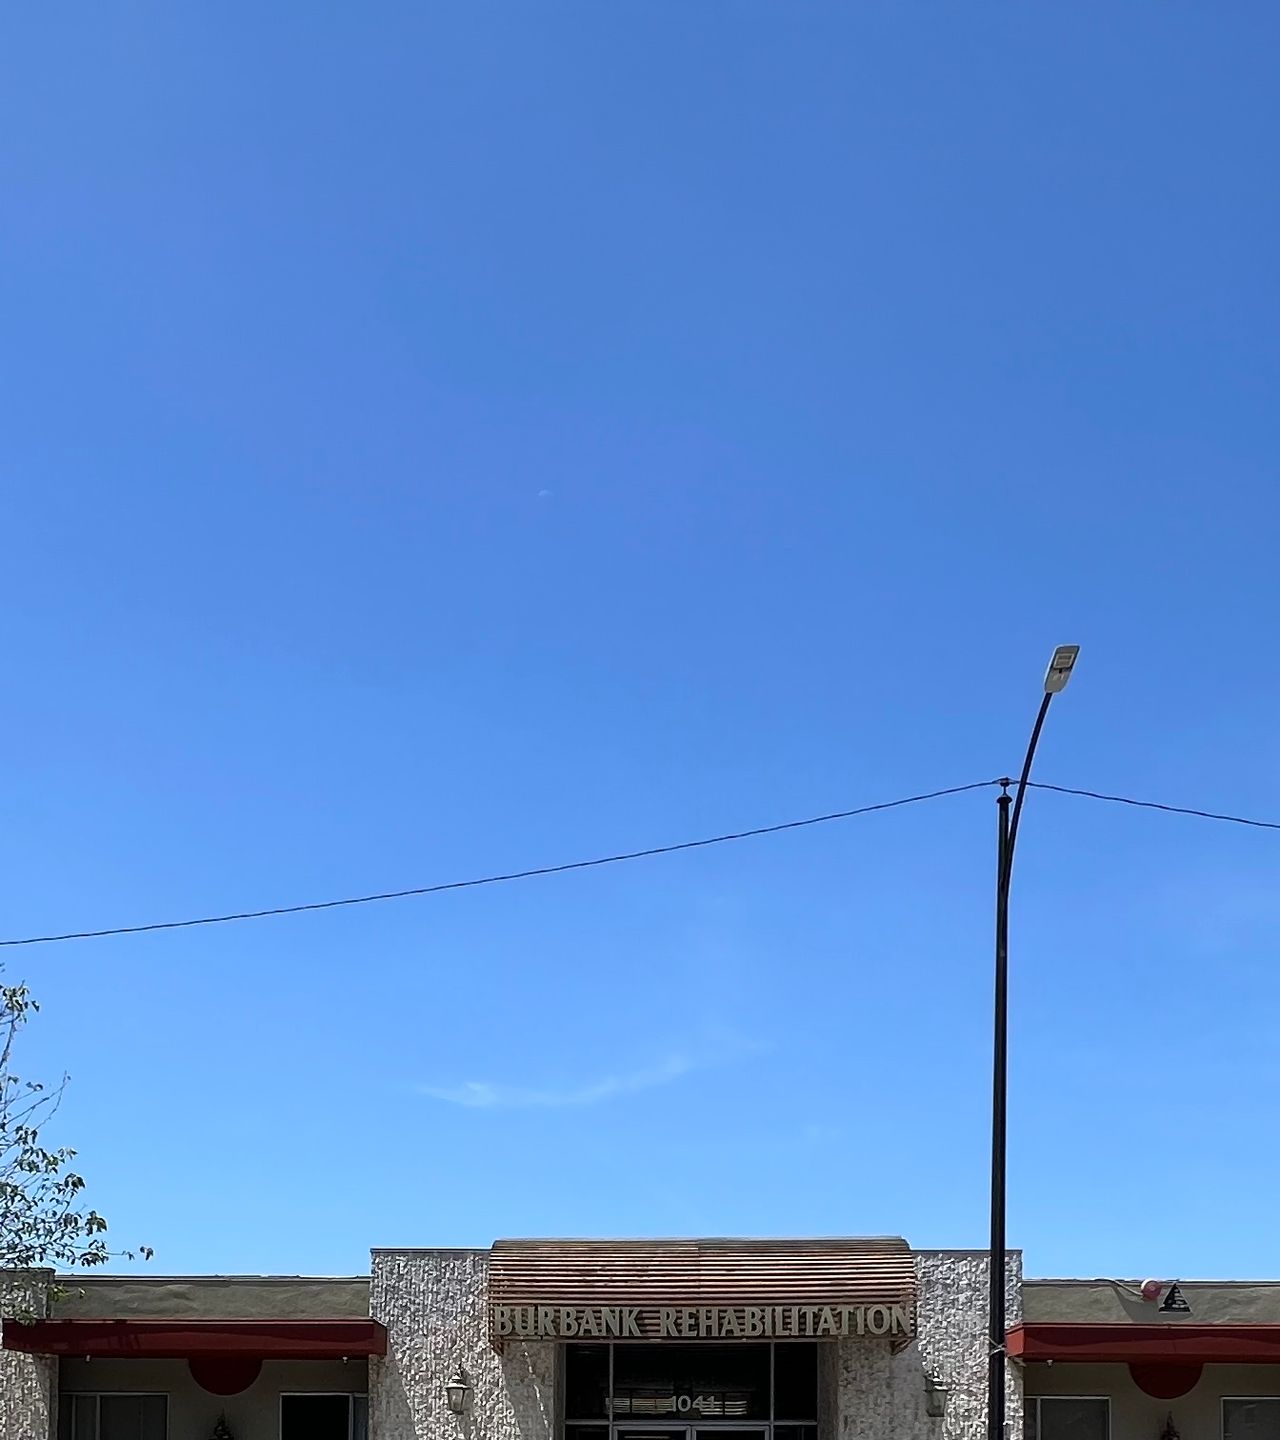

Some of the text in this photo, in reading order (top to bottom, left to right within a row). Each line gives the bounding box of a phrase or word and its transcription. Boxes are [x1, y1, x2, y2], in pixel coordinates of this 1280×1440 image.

[494, 1304, 912, 1337] BURBANK REHABILITATION
[672, 1395, 715, 1412] 1041
